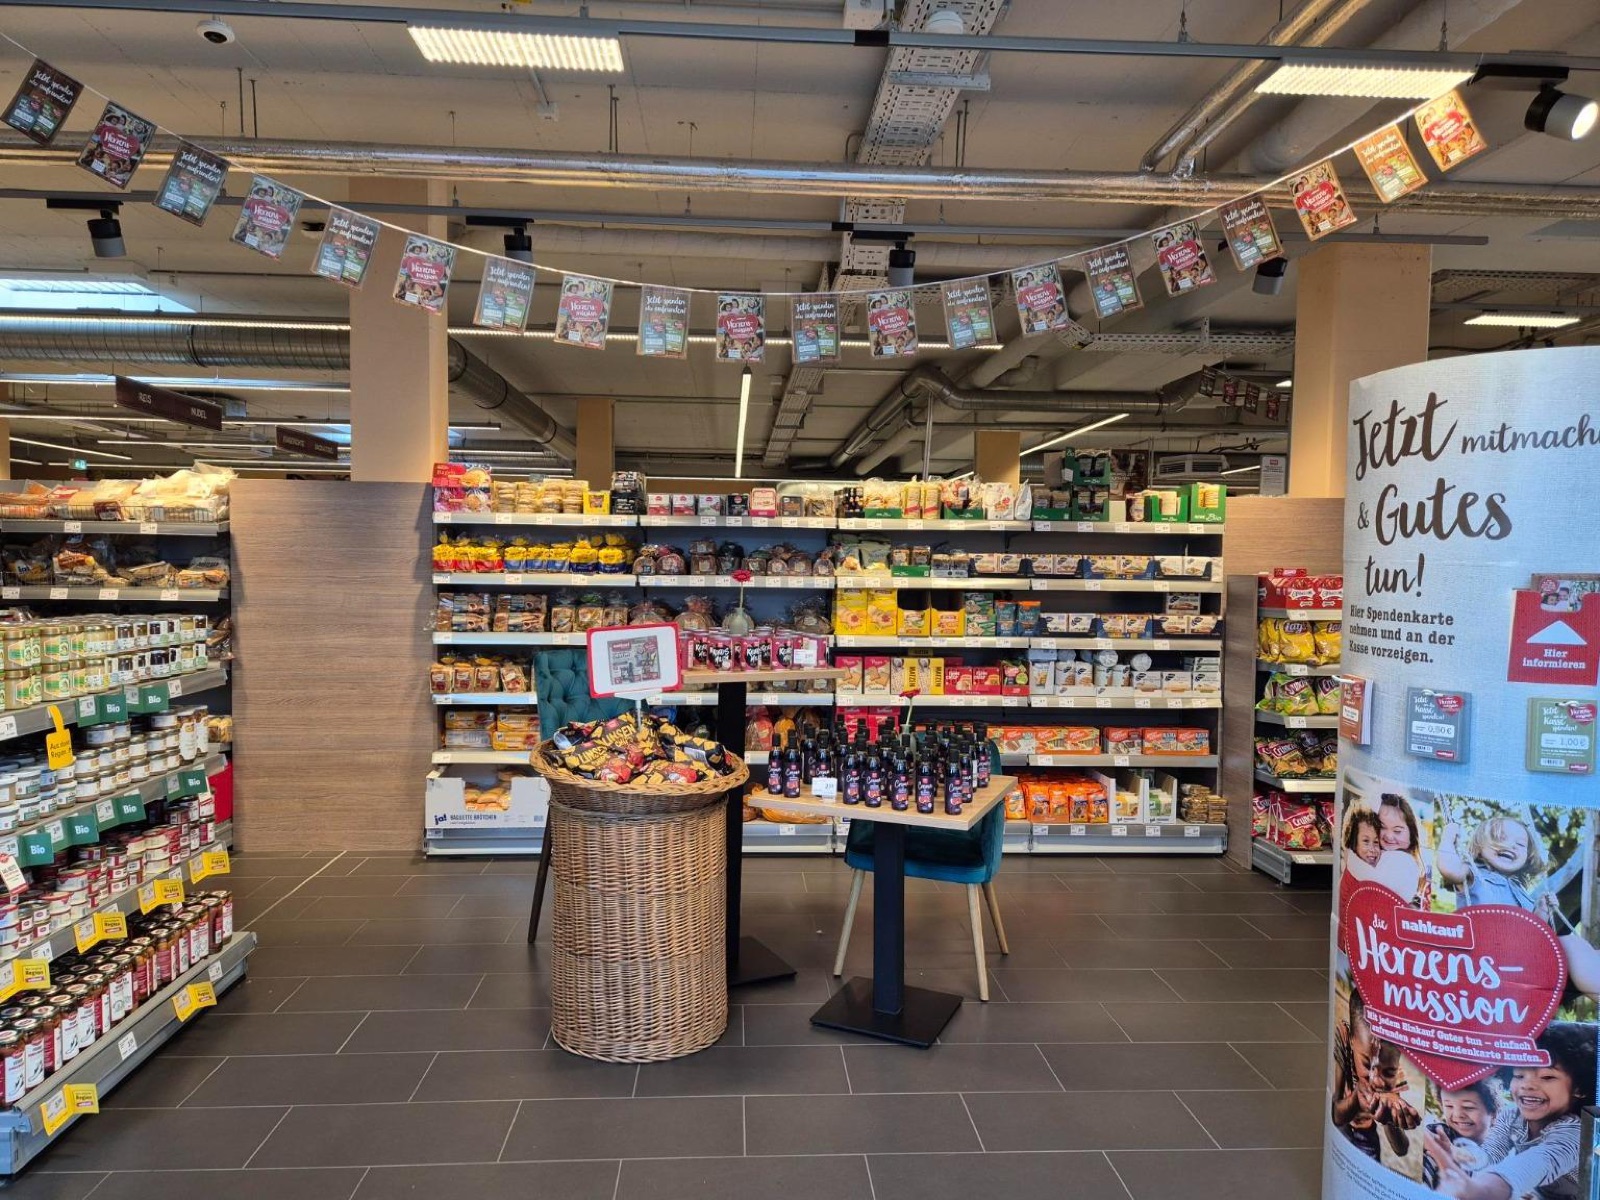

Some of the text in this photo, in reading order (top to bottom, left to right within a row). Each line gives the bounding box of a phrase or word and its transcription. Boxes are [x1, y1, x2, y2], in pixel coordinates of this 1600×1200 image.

[1353, 392, 1600, 481] Jetzt mitmach
[1357, 478, 1512, 546] & Gutes
[1365, 553, 1425, 598] tun!
[1350, 605, 1454, 625] Hier Spendenkarte
[1350, 625, 1455, 645] nehmen und an der
[1350, 641, 1433, 663] Kasse vorzeigen.
[1543, 649, 1568, 658] Hier
[1522, 658, 1586, 669] informieren
[106, 704, 120, 713] Bio
[148, 695, 161, 704] Bio
[602, 724, 637, 747] LINSEN
[123, 805, 137, 814] Bio
[434, 813, 447, 825] ja!
[75, 825, 90, 834] Bio
[30, 845, 45, 854] Bio
[1373, 915, 1388, 930] die
[1401, 919, 1465, 938] nahkauf
[1356, 916, 1523, 989] Herzens-
[1384, 980, 1529, 1025] mission
[1379, 1015, 1400, 1029] jedem
[1402, 1022, 1435, 1037] Einkauf
[1437, 1030, 1463, 1042] Gutes
[1466, 1035, 1482, 1045] tun
[1494, 1040, 1530, 1050] einfach
[1411, 1035, 1430, 1048] oder
[1432, 1040, 1500, 1060] Spendenkarte
[1503, 1051, 1543, 1063] kaufen.
